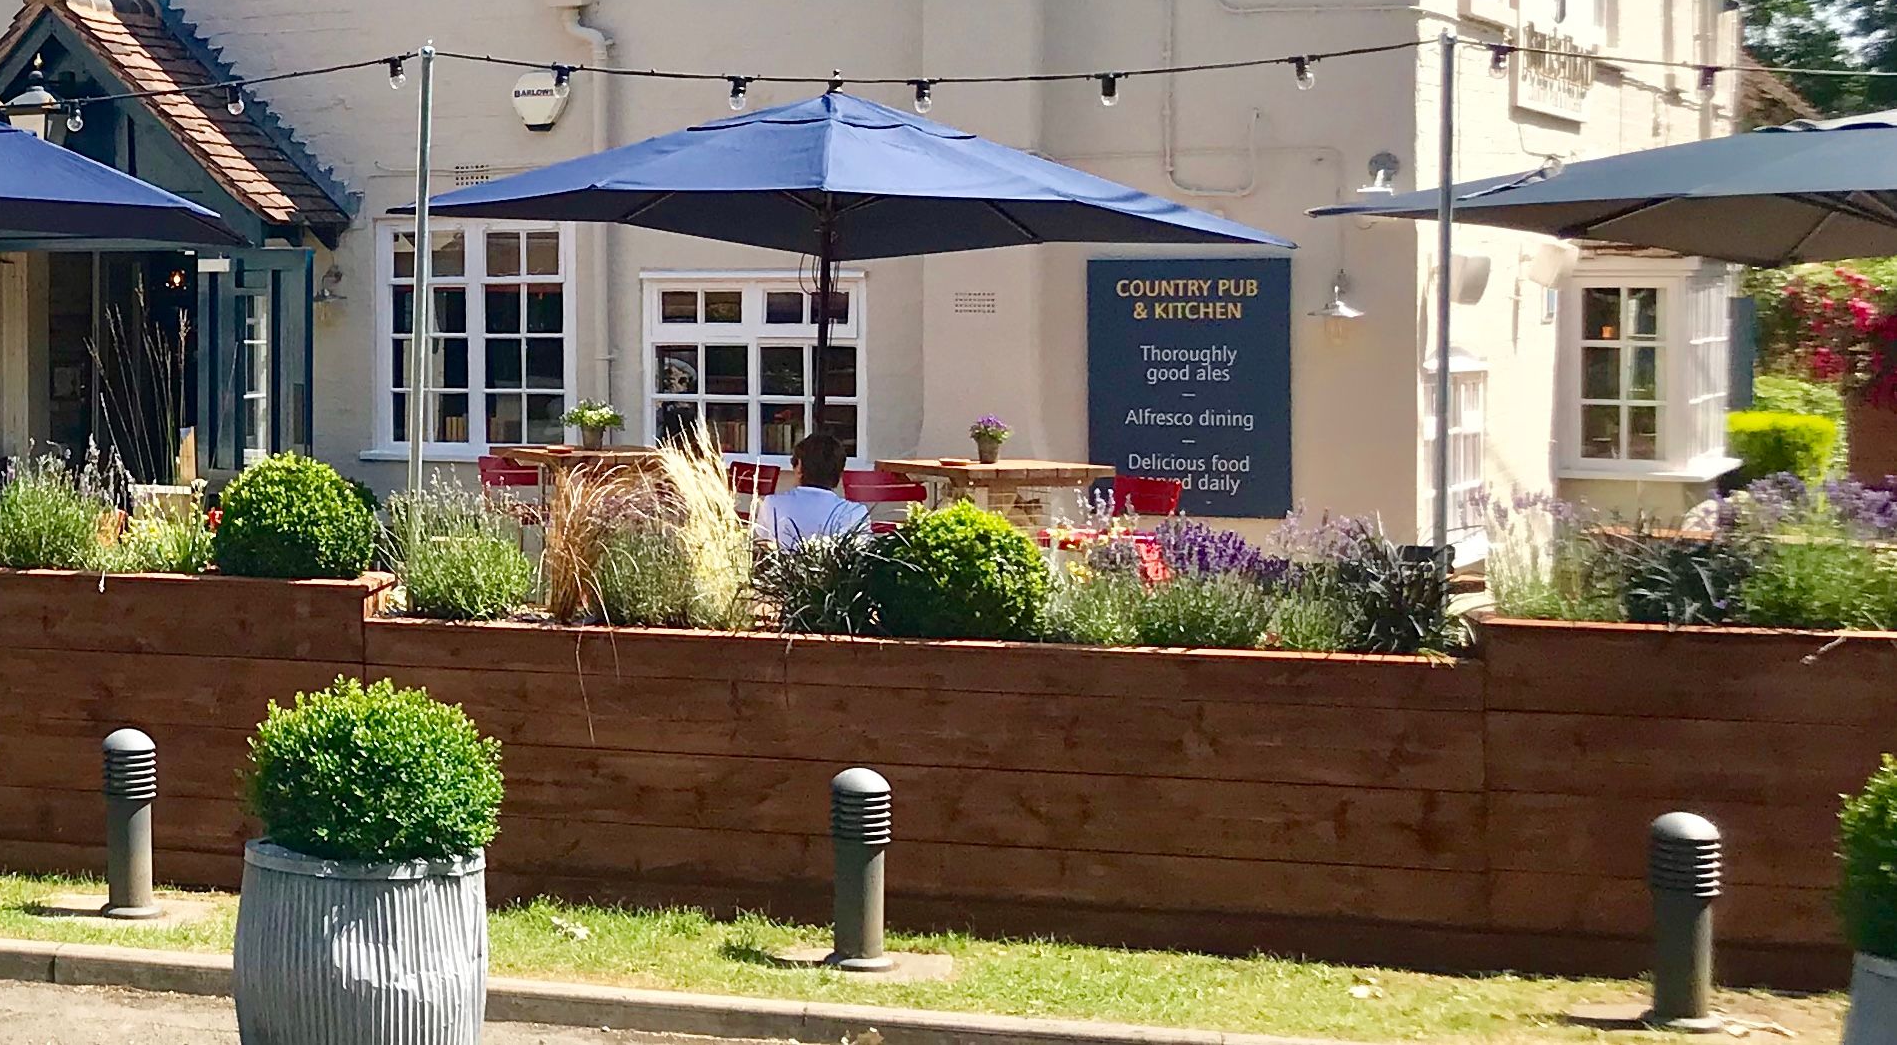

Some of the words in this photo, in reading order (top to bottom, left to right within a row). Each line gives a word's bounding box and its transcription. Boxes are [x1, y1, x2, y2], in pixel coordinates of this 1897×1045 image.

[1116, 280, 1212, 298] COUNTRY
[1218, 280, 1258, 297] PUB
[1133, 302, 1148, 319] &
[1154, 302, 1242, 319] KITCHEN
[1140, 345, 1238, 366] Thoroughly
[1146, 366, 1190, 384] good
[1196, 366, 1230, 381] ales
[1124, 409, 1193, 426] Alfresco
[1198, 409, 1254, 430] dining
[1128, 454, 1206, 472] Delicious
[1212, 454, 1250, 472] food
[1198, 474, 1241, 496] daily
